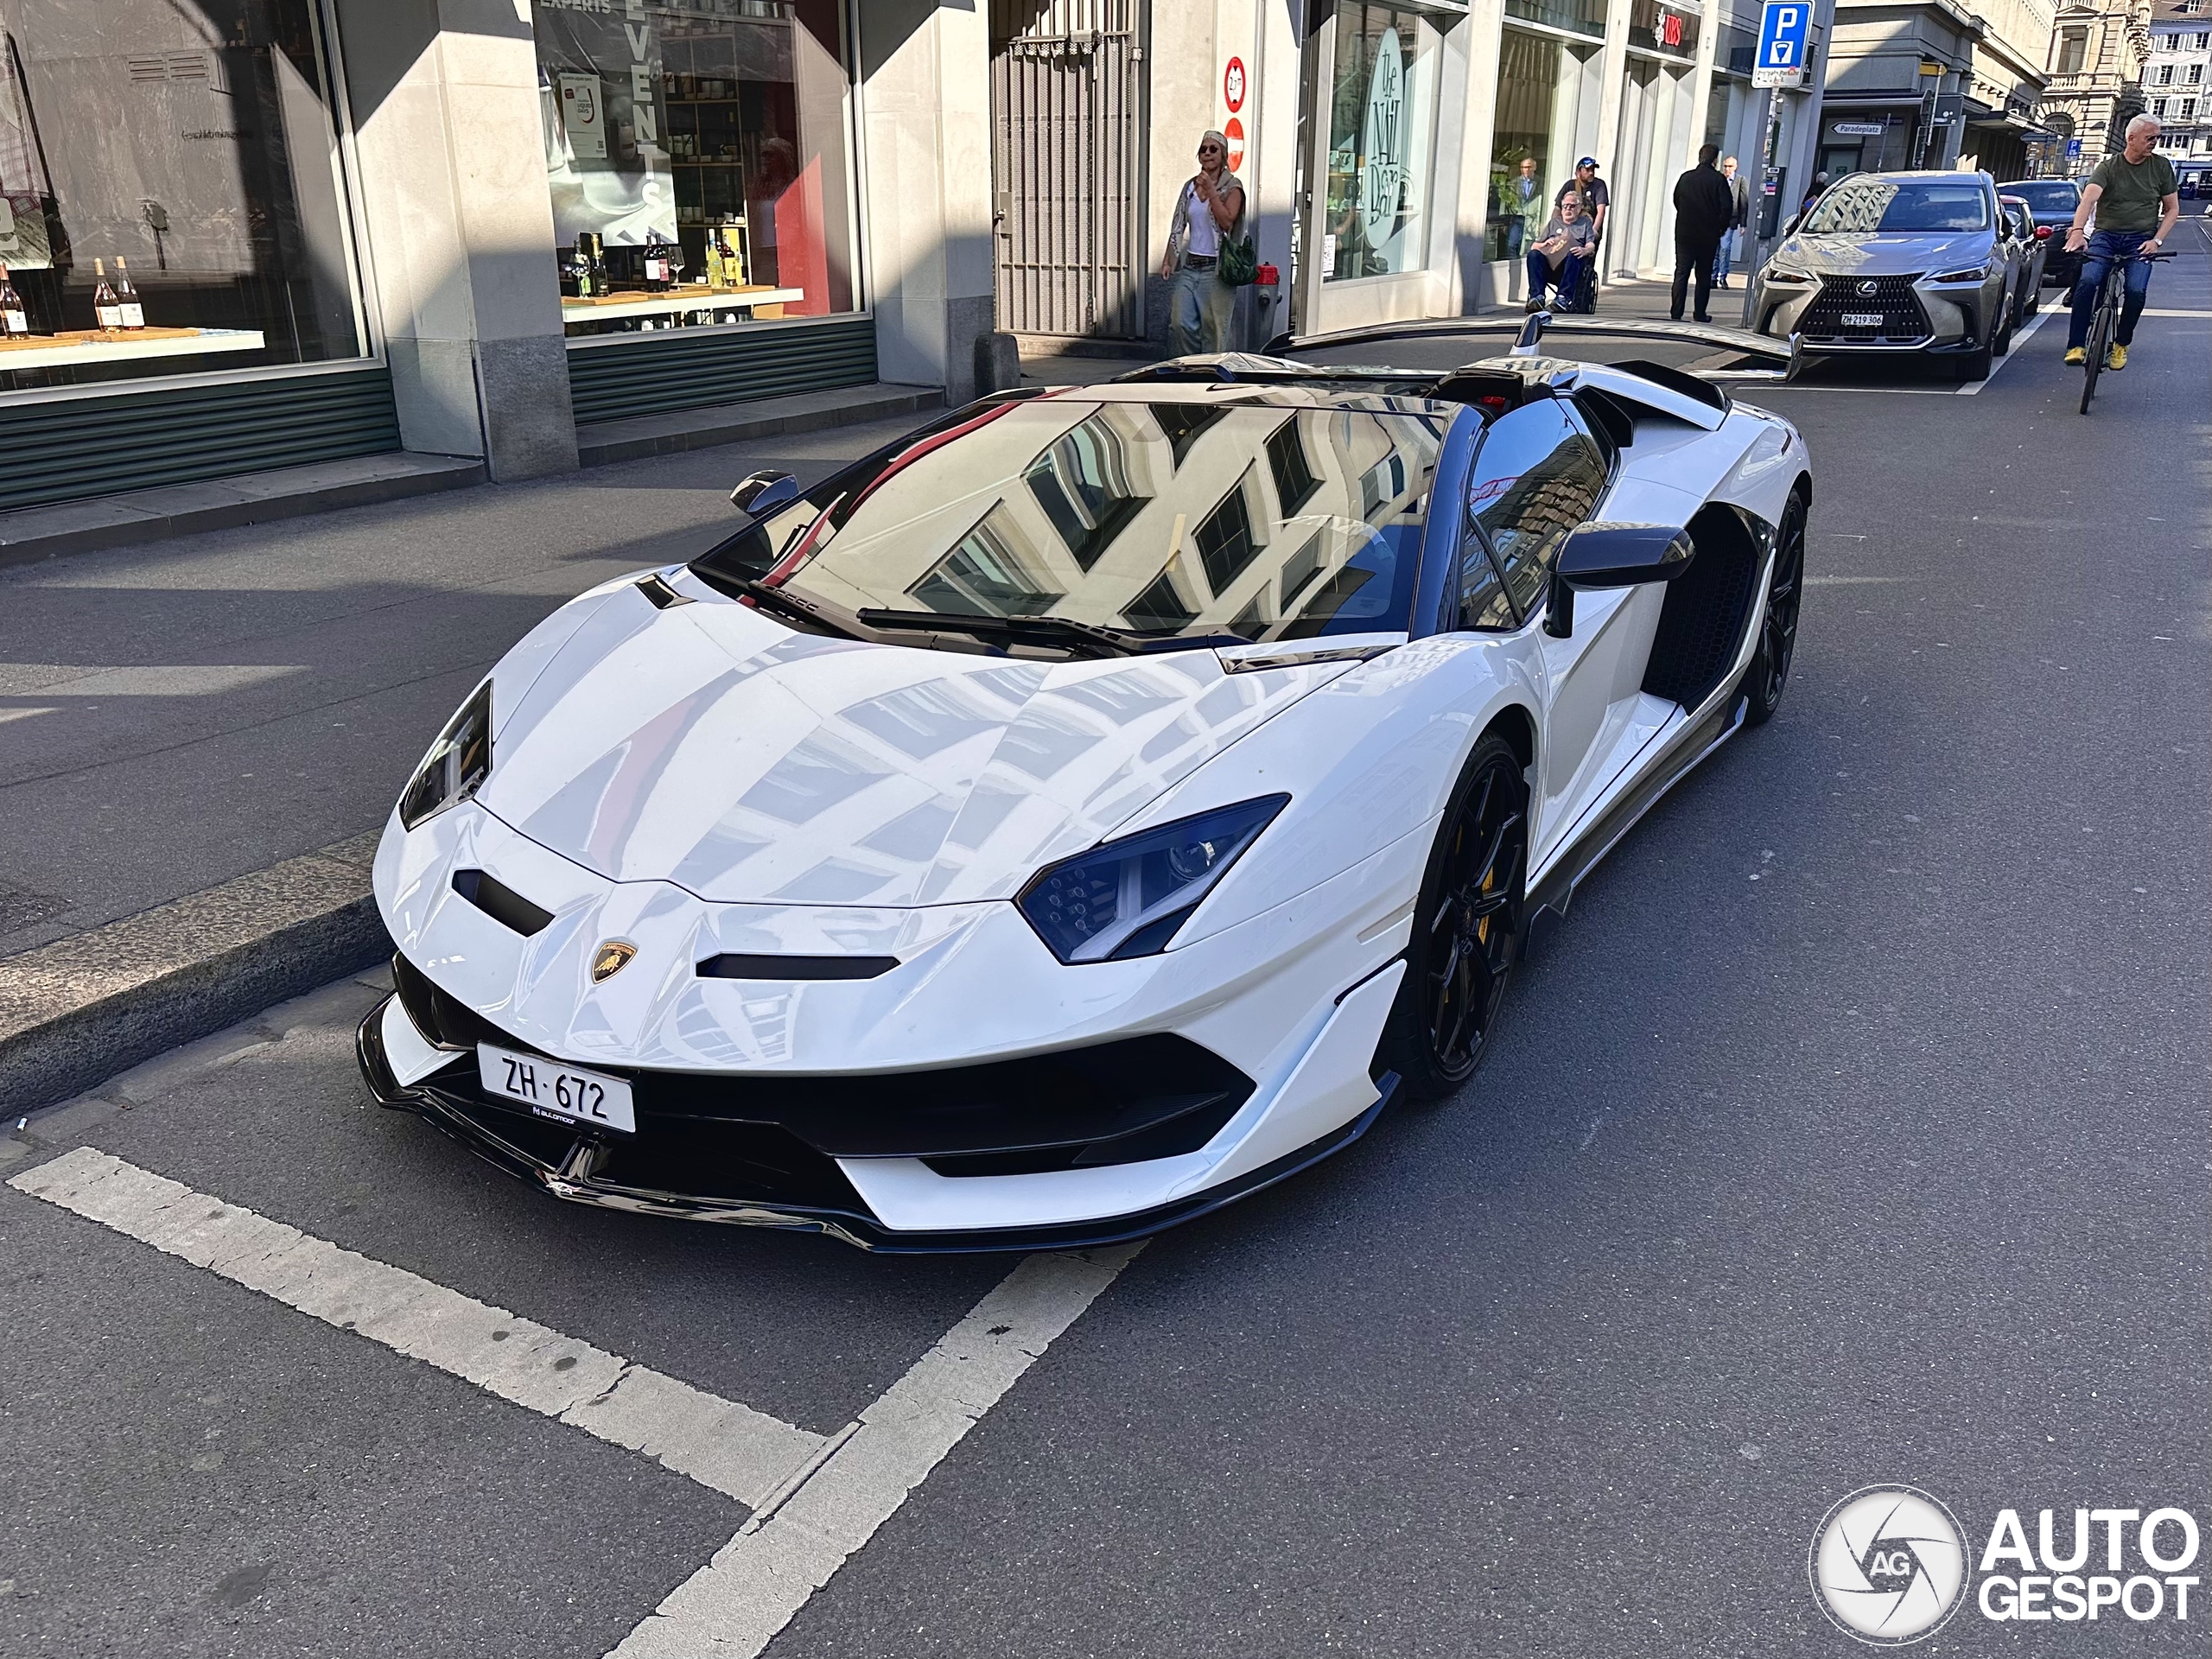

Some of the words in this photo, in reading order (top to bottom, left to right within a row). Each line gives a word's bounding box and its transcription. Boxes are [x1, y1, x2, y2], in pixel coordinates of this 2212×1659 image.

[1665, 15, 1682, 46] UBS
[1776, 7, 1798, 39] P
[1369, 163, 1399, 226] Bar
